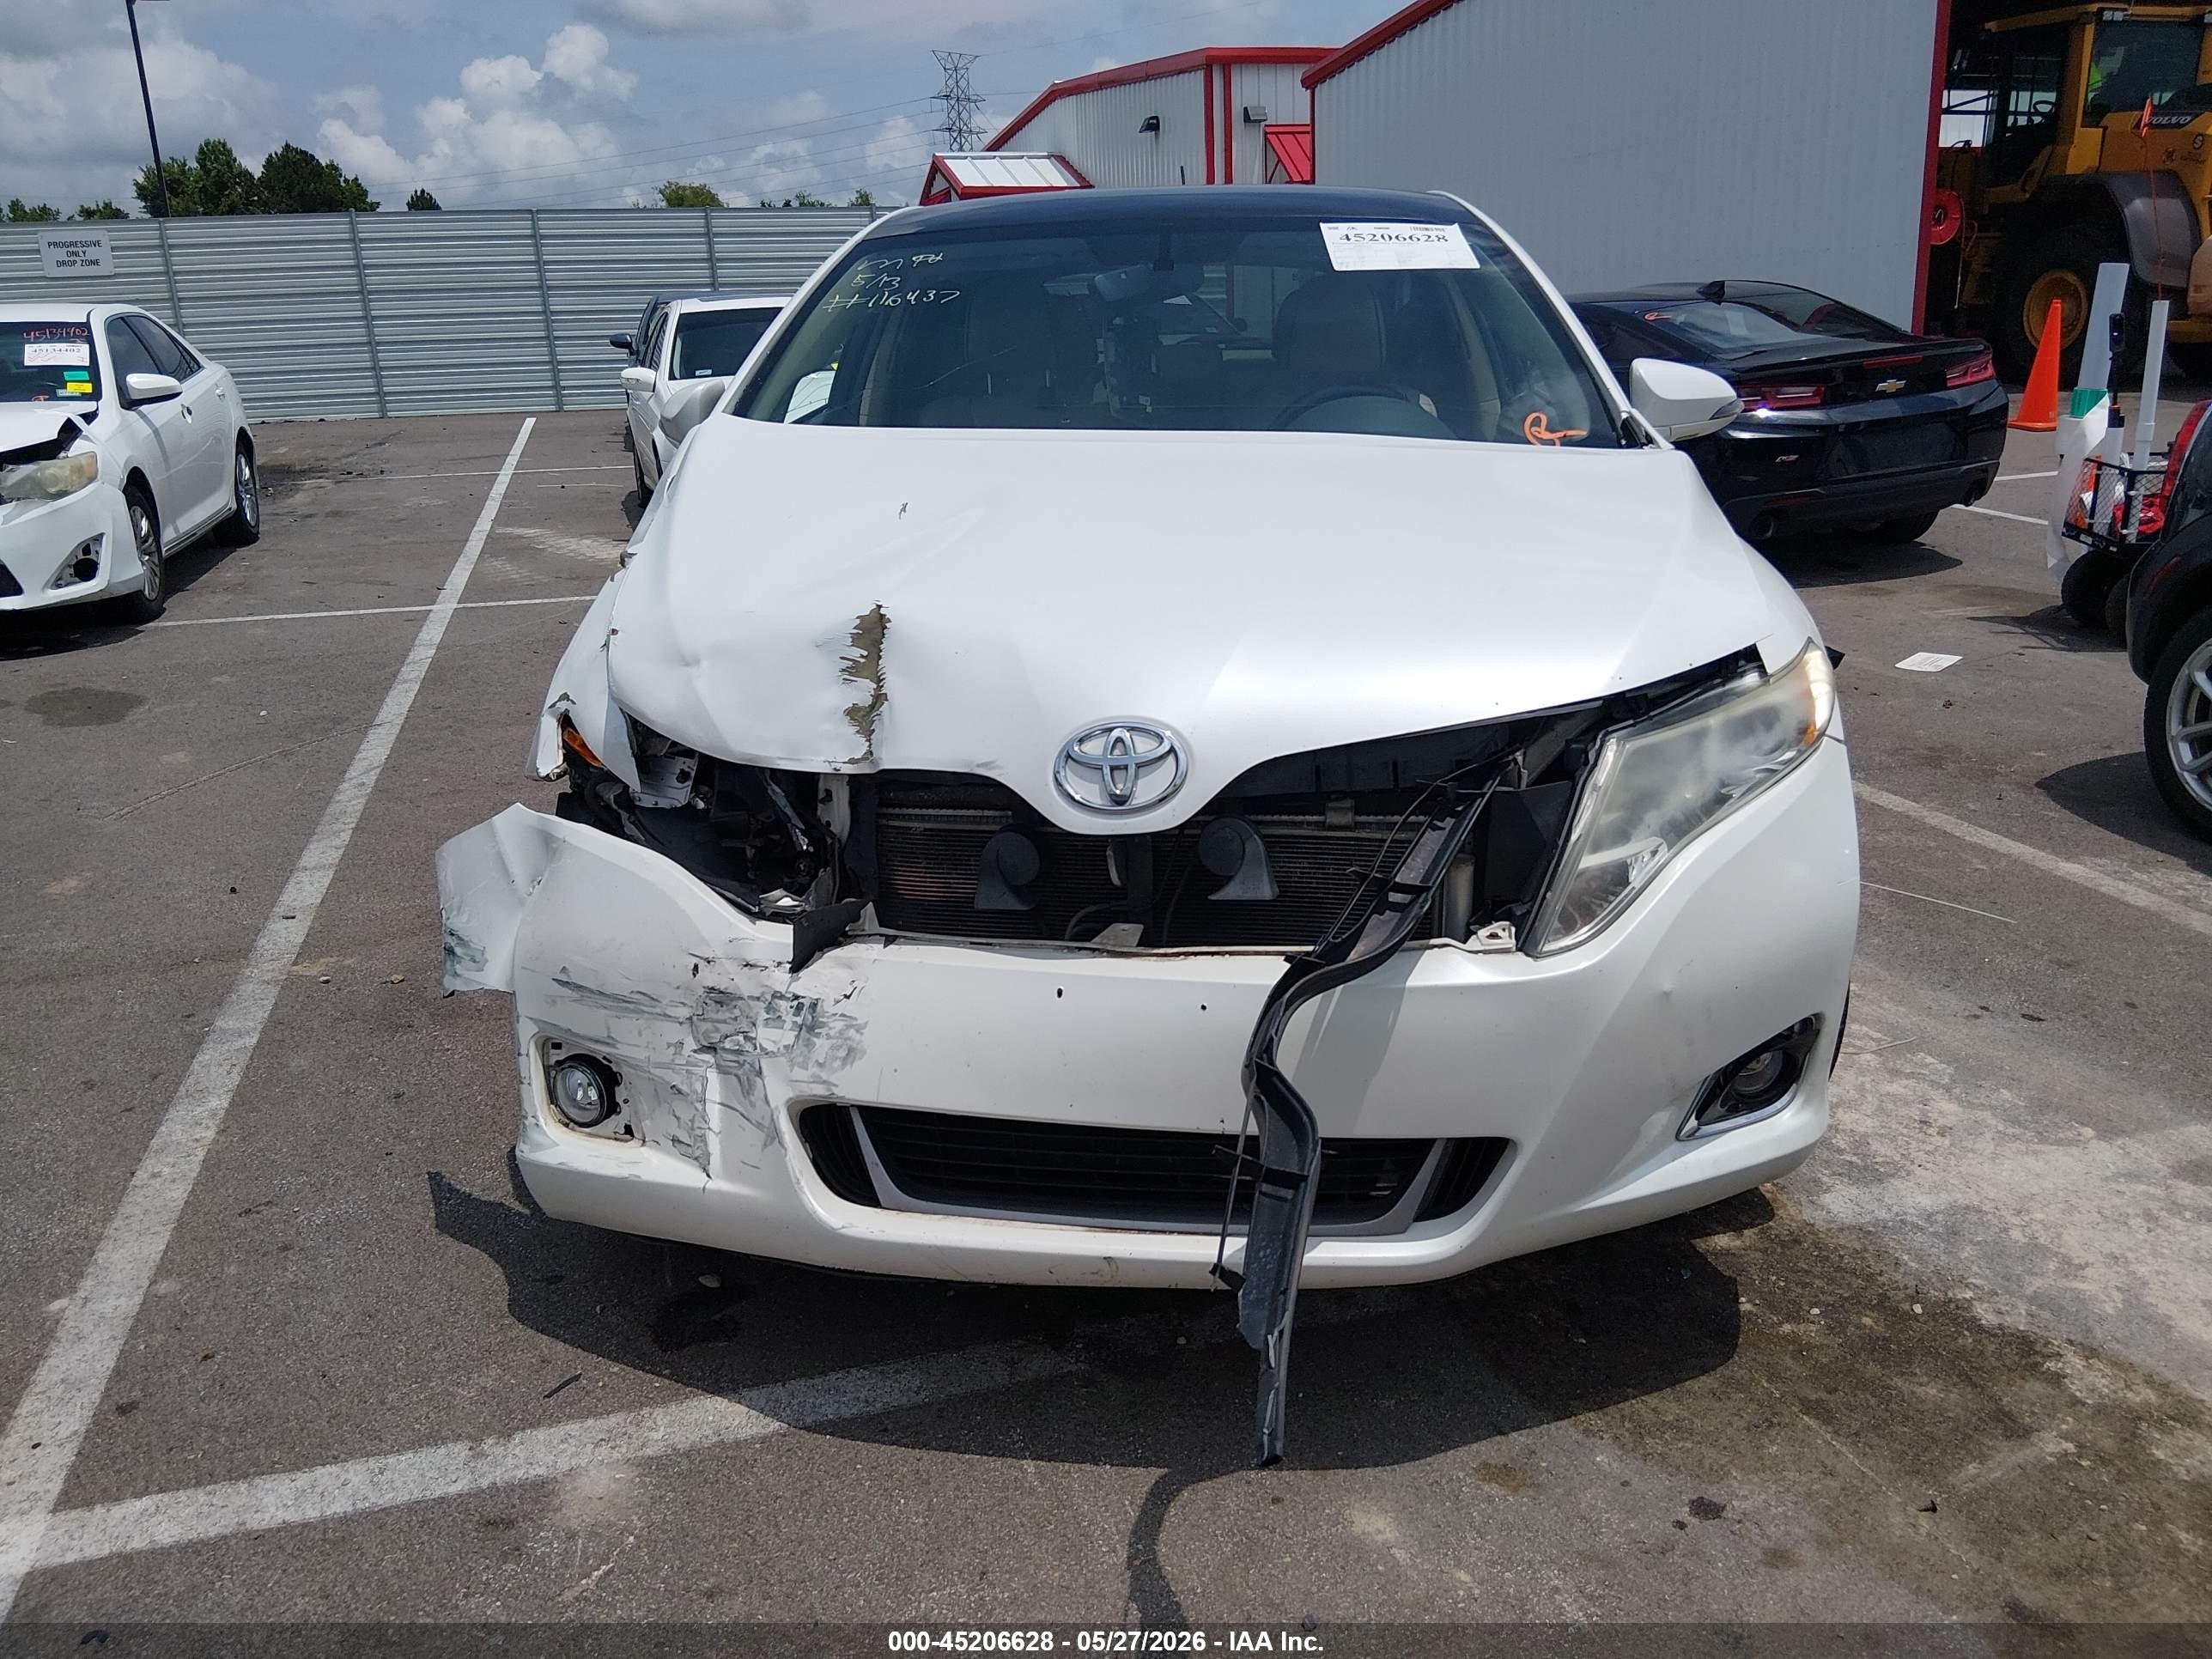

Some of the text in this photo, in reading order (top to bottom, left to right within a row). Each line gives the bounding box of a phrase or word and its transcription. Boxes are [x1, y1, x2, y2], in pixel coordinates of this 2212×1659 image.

[1340, 233, 1449, 243] 45206628
[47, 240, 103, 249] PROGRESSIVE
[65, 250, 87, 258] ONLY
[56, 258, 101, 268] DROP ZONE
[851, 272, 901, 290] 5/13
